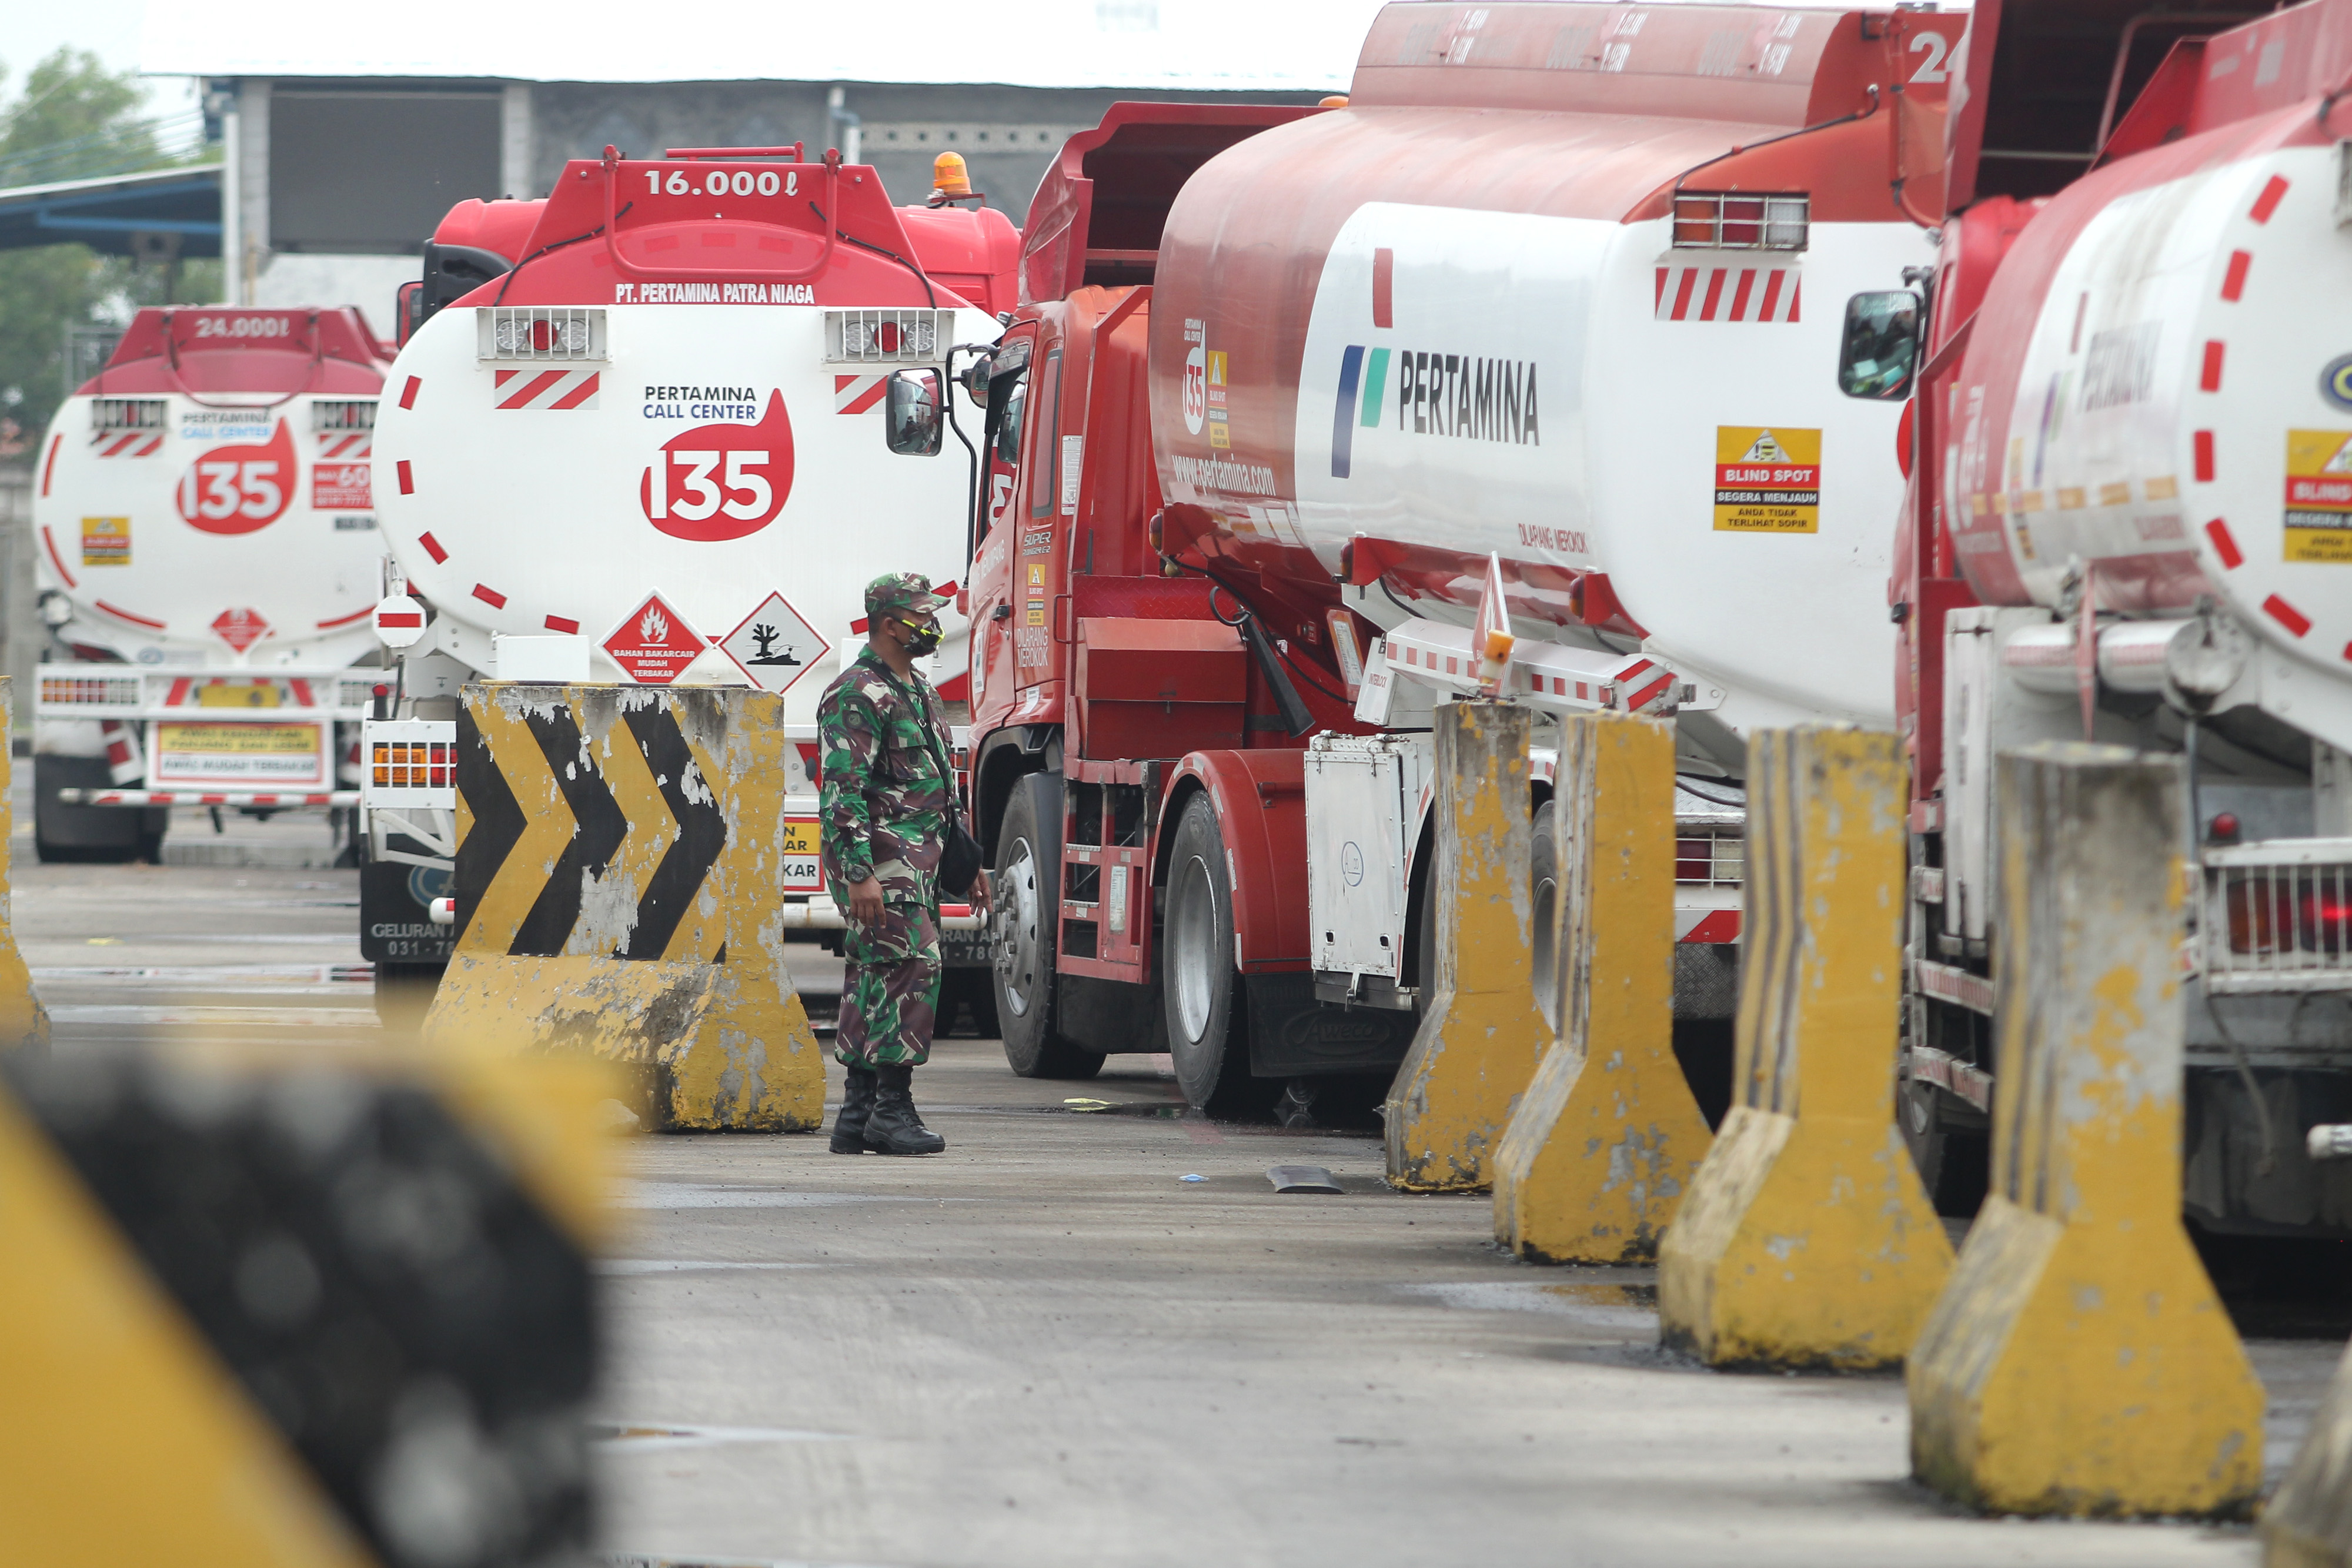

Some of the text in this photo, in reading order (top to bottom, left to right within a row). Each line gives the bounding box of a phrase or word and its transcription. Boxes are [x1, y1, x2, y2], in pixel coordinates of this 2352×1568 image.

[616, 283, 816, 305] PT. PERTAMINA PATRA NIAGA
[645, 386, 757, 402] PERTAMINA
[1399, 349, 1541, 446] PERTAMINA
[182, 412, 272, 423] PERTAMINA
[643, 404, 757, 419] CALL CENTER
[181, 426, 272, 439] CALL CENTER
[1171, 452, 1277, 497] www.pertamina.com
[1725, 469, 1813, 483] BLIND SPOT
[183, 460, 283, 520] 135
[646, 449, 773, 521] 135
[1717, 492, 1817, 503] SEGERA MENJAUH
[1738, 508, 1798, 517] ANDA TIDAK
[1728, 519, 1808, 527] TERLIHAT SOPIR
[1023, 531, 1052, 547] SUPER
[1017, 627, 1048, 648] DILARANG
[613, 649, 644, 657] BAHAN
[1017, 647, 1048, 668] MEROKOK
[637, 659, 668, 667] MUDAH
[632, 669, 674, 677] TERBAKAR
[370, 922, 446, 938] GELURAN
[387, 940, 419, 956] 031
